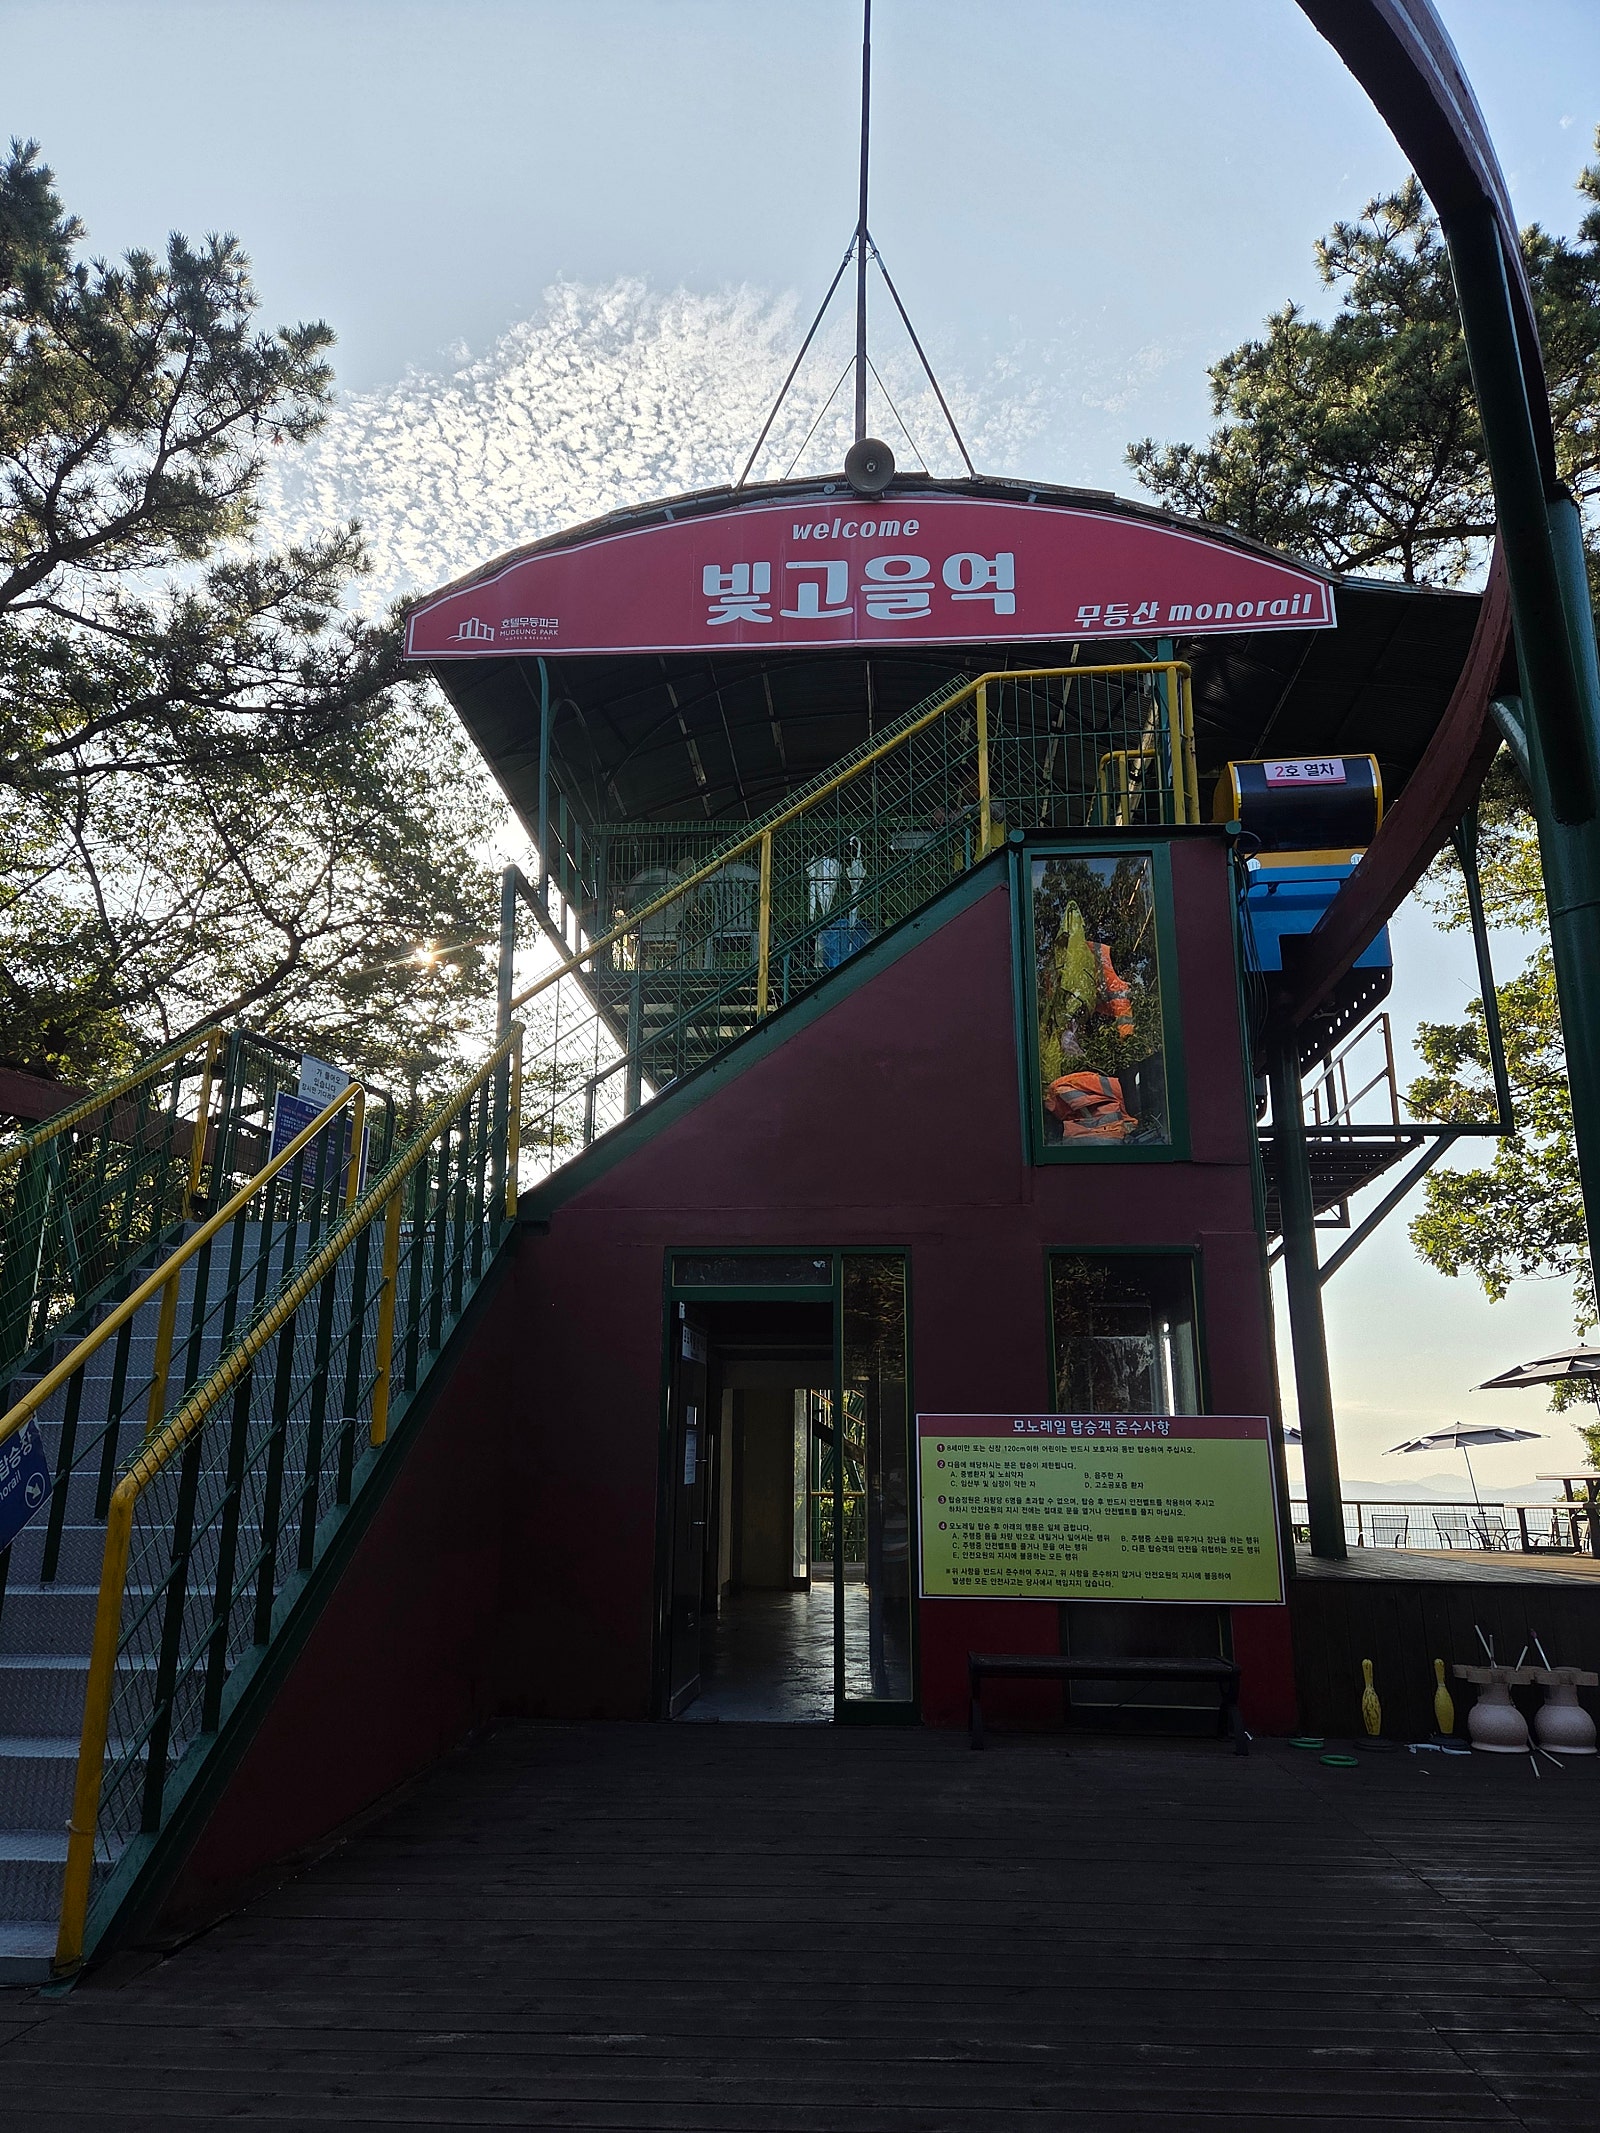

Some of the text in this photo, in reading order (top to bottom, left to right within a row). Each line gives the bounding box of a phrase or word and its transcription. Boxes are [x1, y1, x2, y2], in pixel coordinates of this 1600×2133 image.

[792, 518, 920, 540] welcome
[702, 552, 1015, 625] 빛고을역
[1074, 593, 1312, 628] 무등산 monorail
[500, 617, 559, 628] 호텔무등파크
[500, 629, 537, 637] MUDEUNG
[1275, 763, 1334, 777] 2호 열차
[1013, 1420, 1170, 1436] 모노레일 탑승객 준수사항
